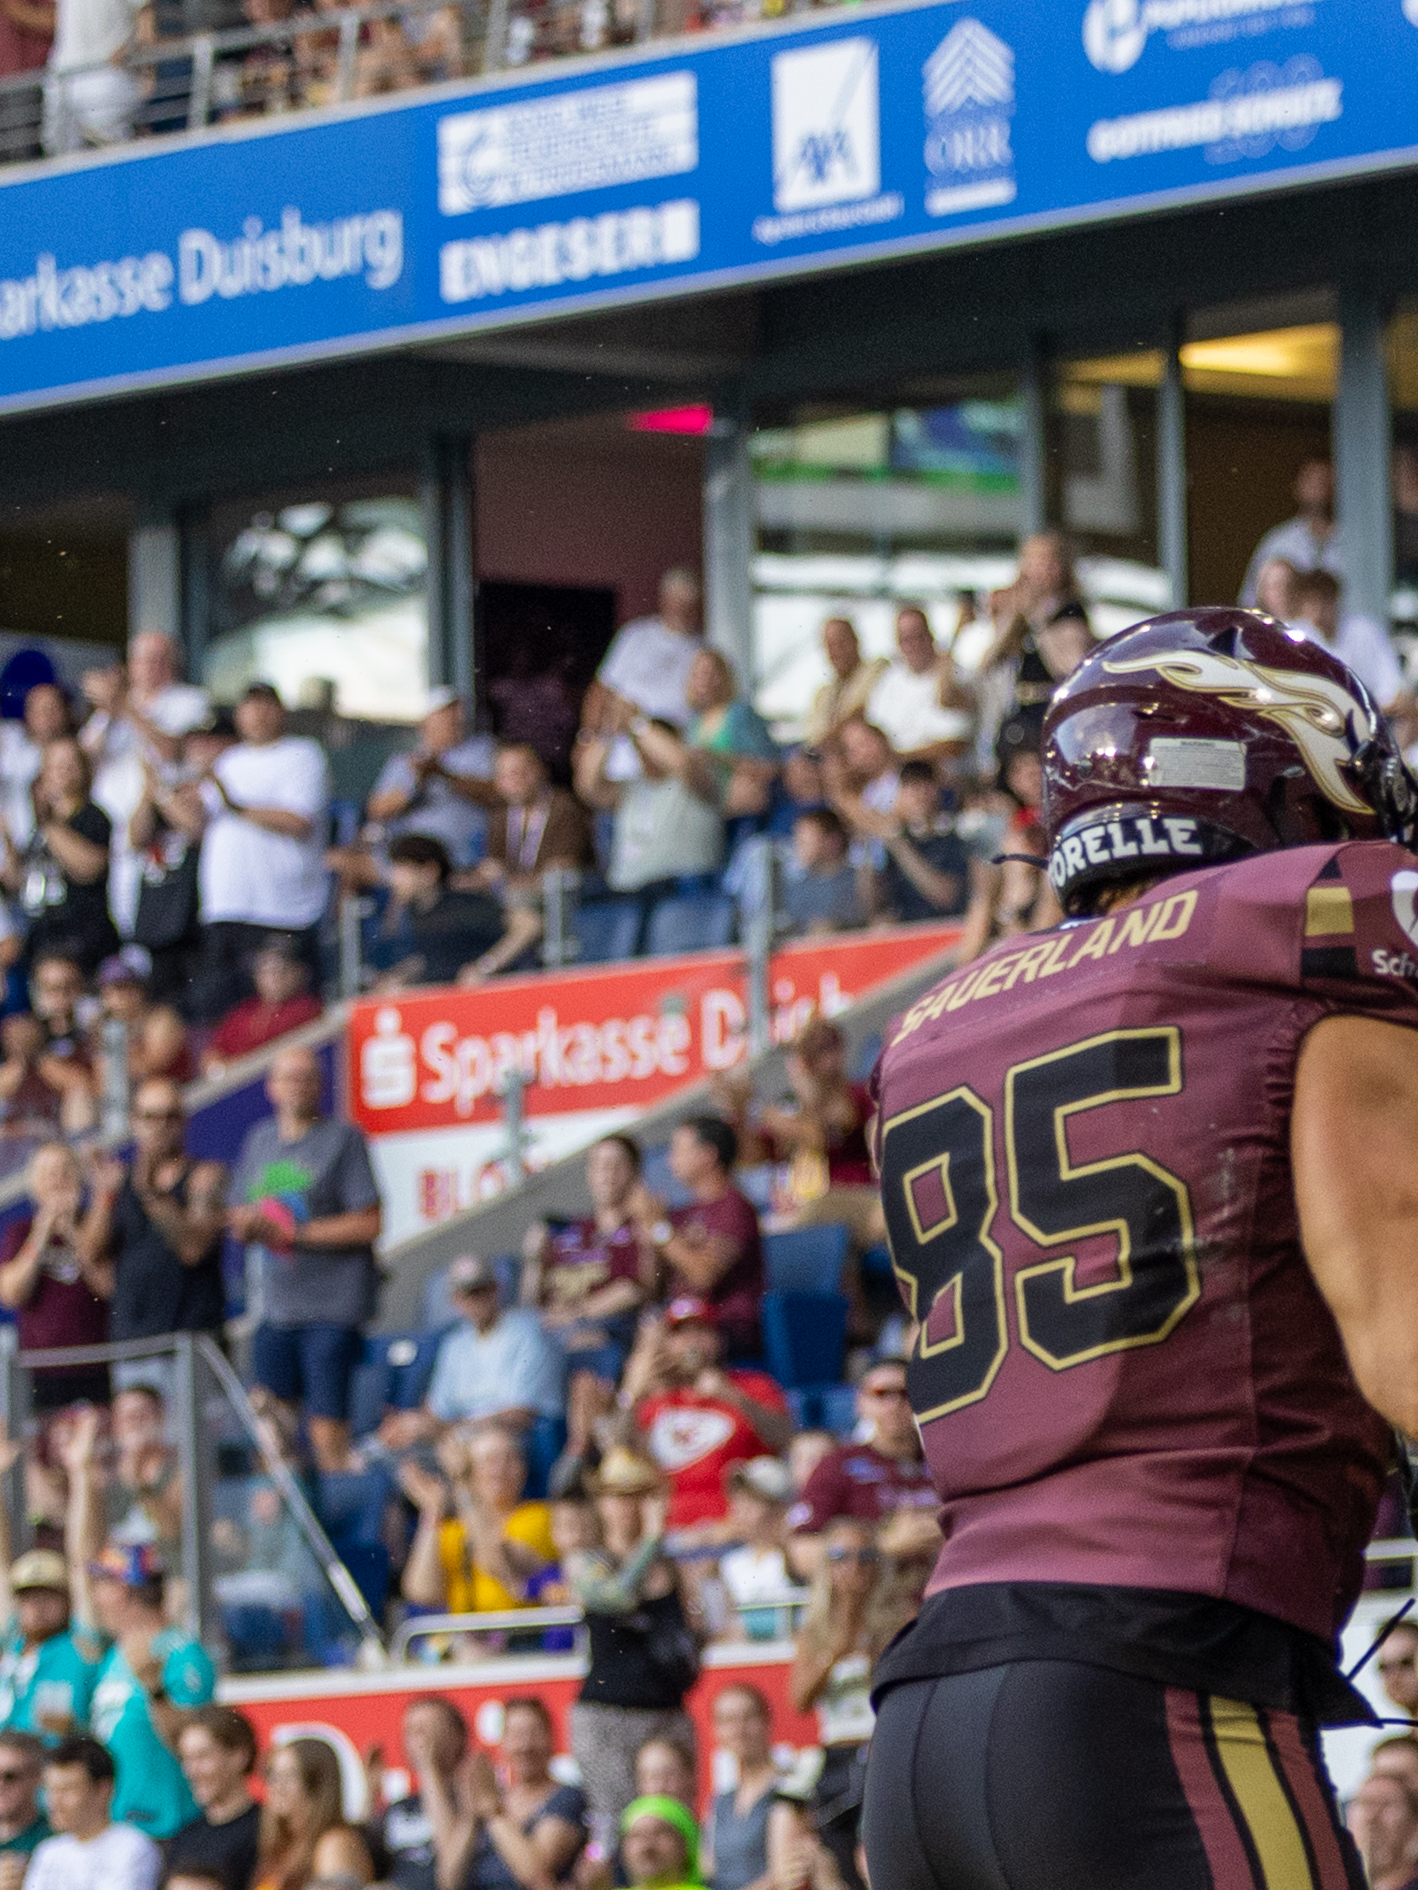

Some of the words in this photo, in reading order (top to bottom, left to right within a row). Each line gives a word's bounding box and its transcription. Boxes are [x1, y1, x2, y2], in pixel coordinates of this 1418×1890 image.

[177, 206, 403, 306] Duisburg
[889, 889, 1199, 1047] SAUERLAND
[418, 1005, 692, 1117] Sparkasse
[878, 1025, 1203, 1426] 85
